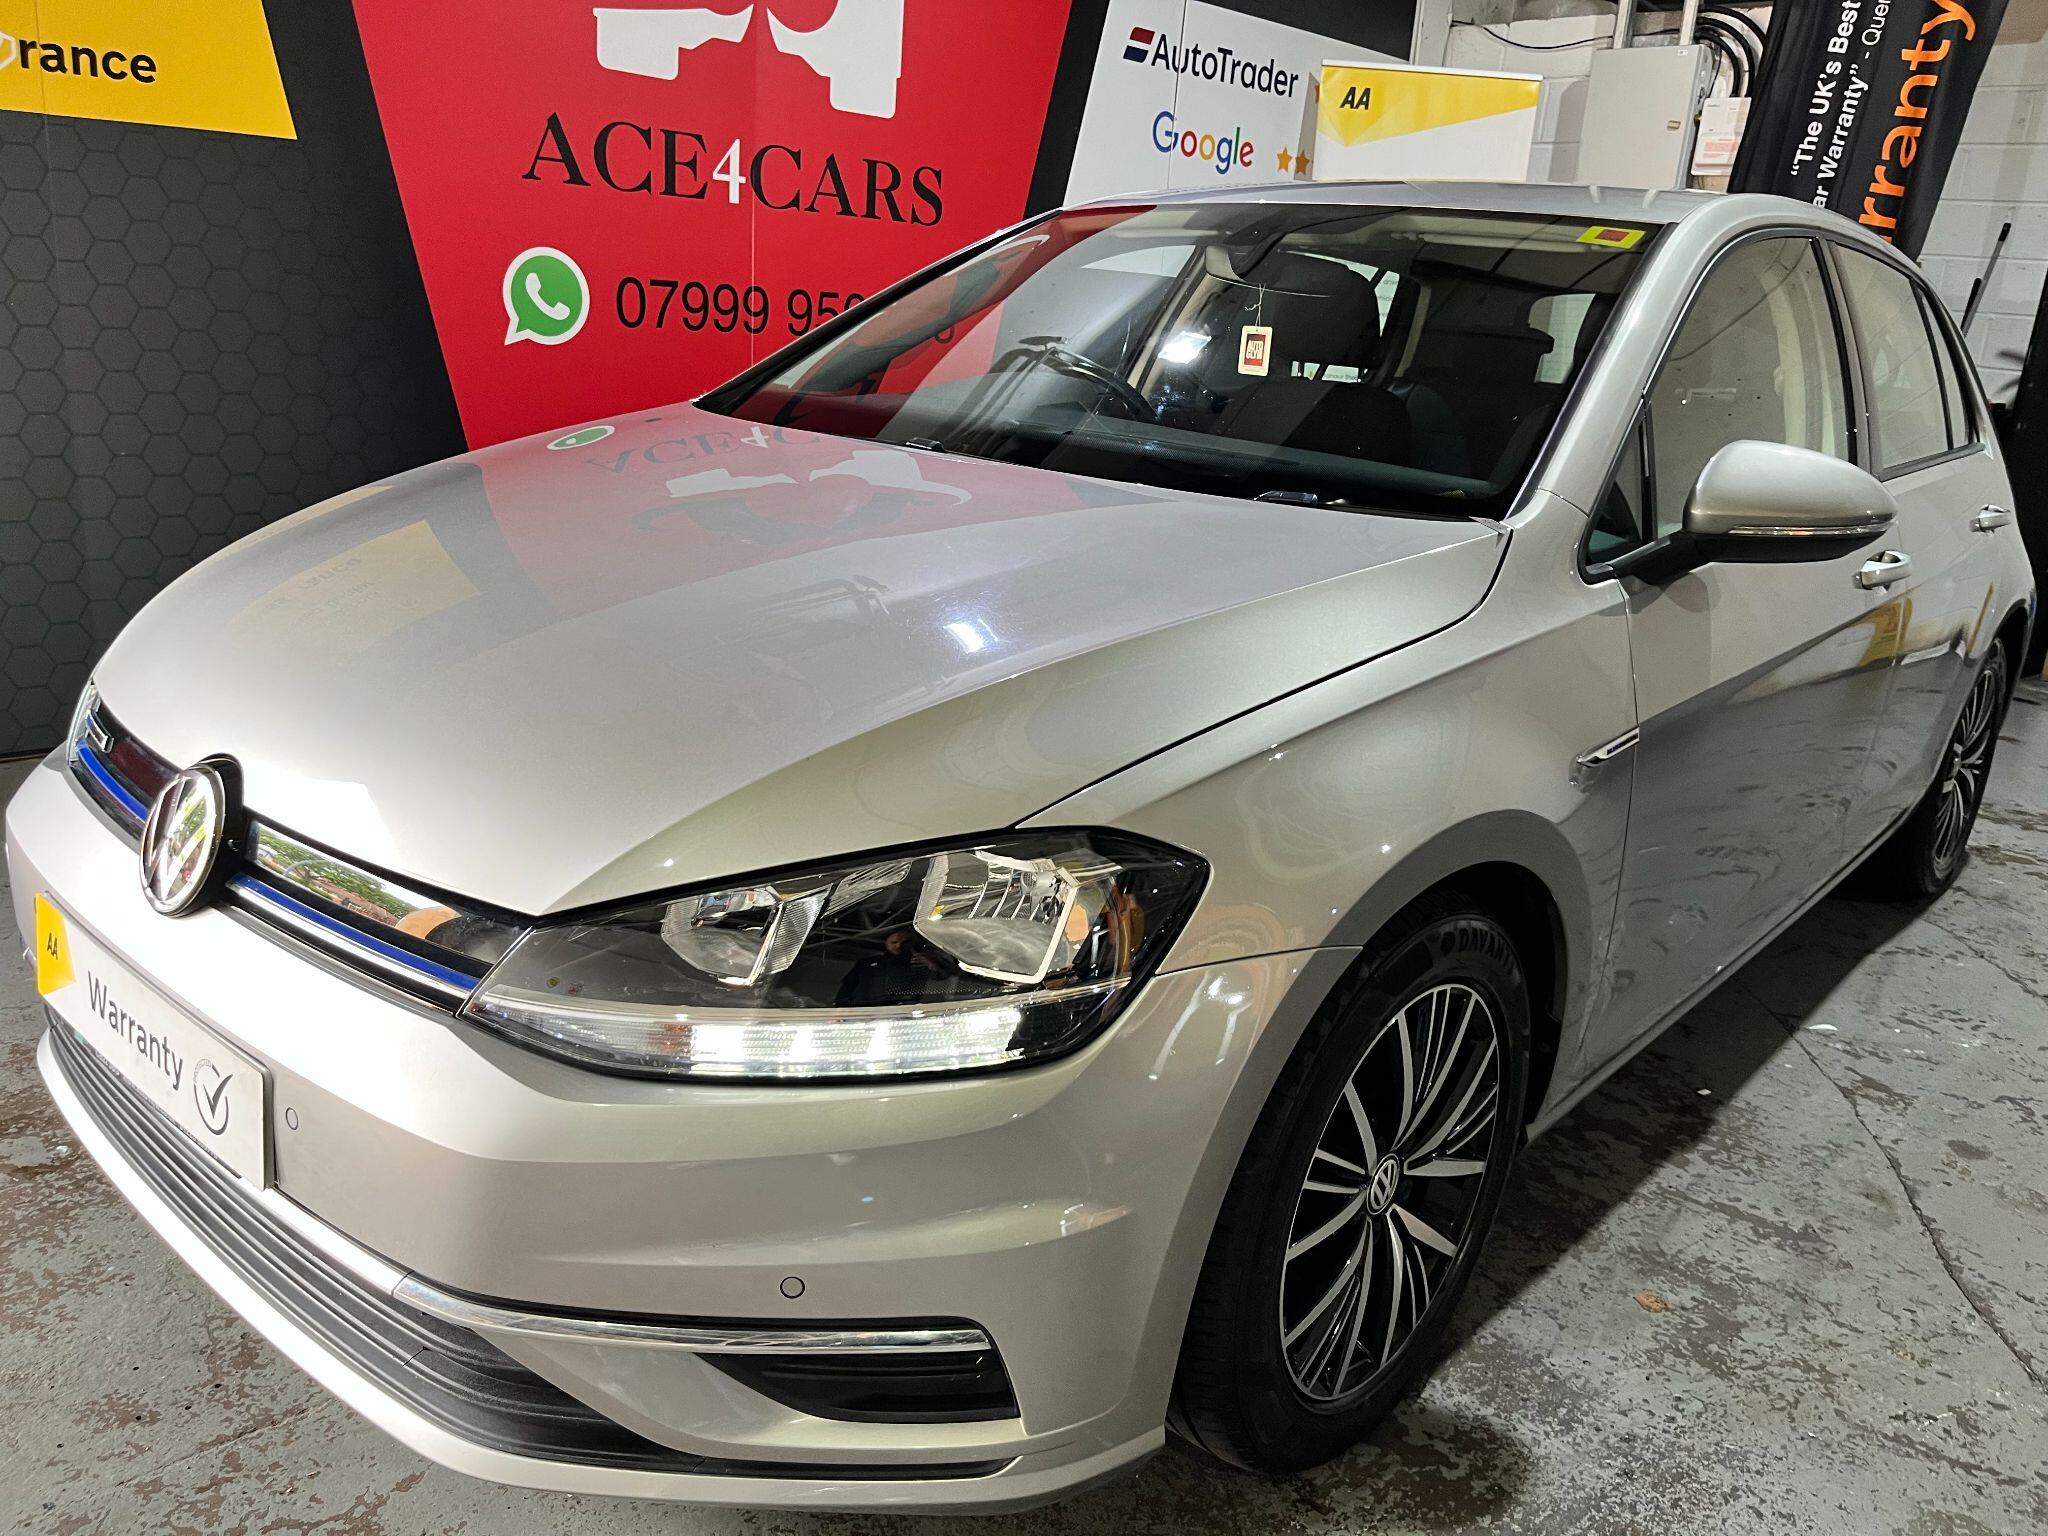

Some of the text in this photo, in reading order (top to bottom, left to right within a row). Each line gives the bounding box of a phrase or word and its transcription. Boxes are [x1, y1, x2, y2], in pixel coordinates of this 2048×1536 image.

[18, 39, 157, 83] rance
[1151, 34, 1299, 98] AutoTrader
[1790, 122, 1823, 176] “The
[1827, 1, 1861, 54] Best
[1340, 87, 1372, 111] AA
[1817, 63, 1869, 179] Warranty”
[1858, 0, 1976, 243] rranty
[521, 111, 943, 226] ACE4CARS
[1152, 110, 1254, 175] Google
[616, 277, 770, 335] 07999
[46, 932, 59, 961] AA
[88, 970, 185, 1091] Warranty
